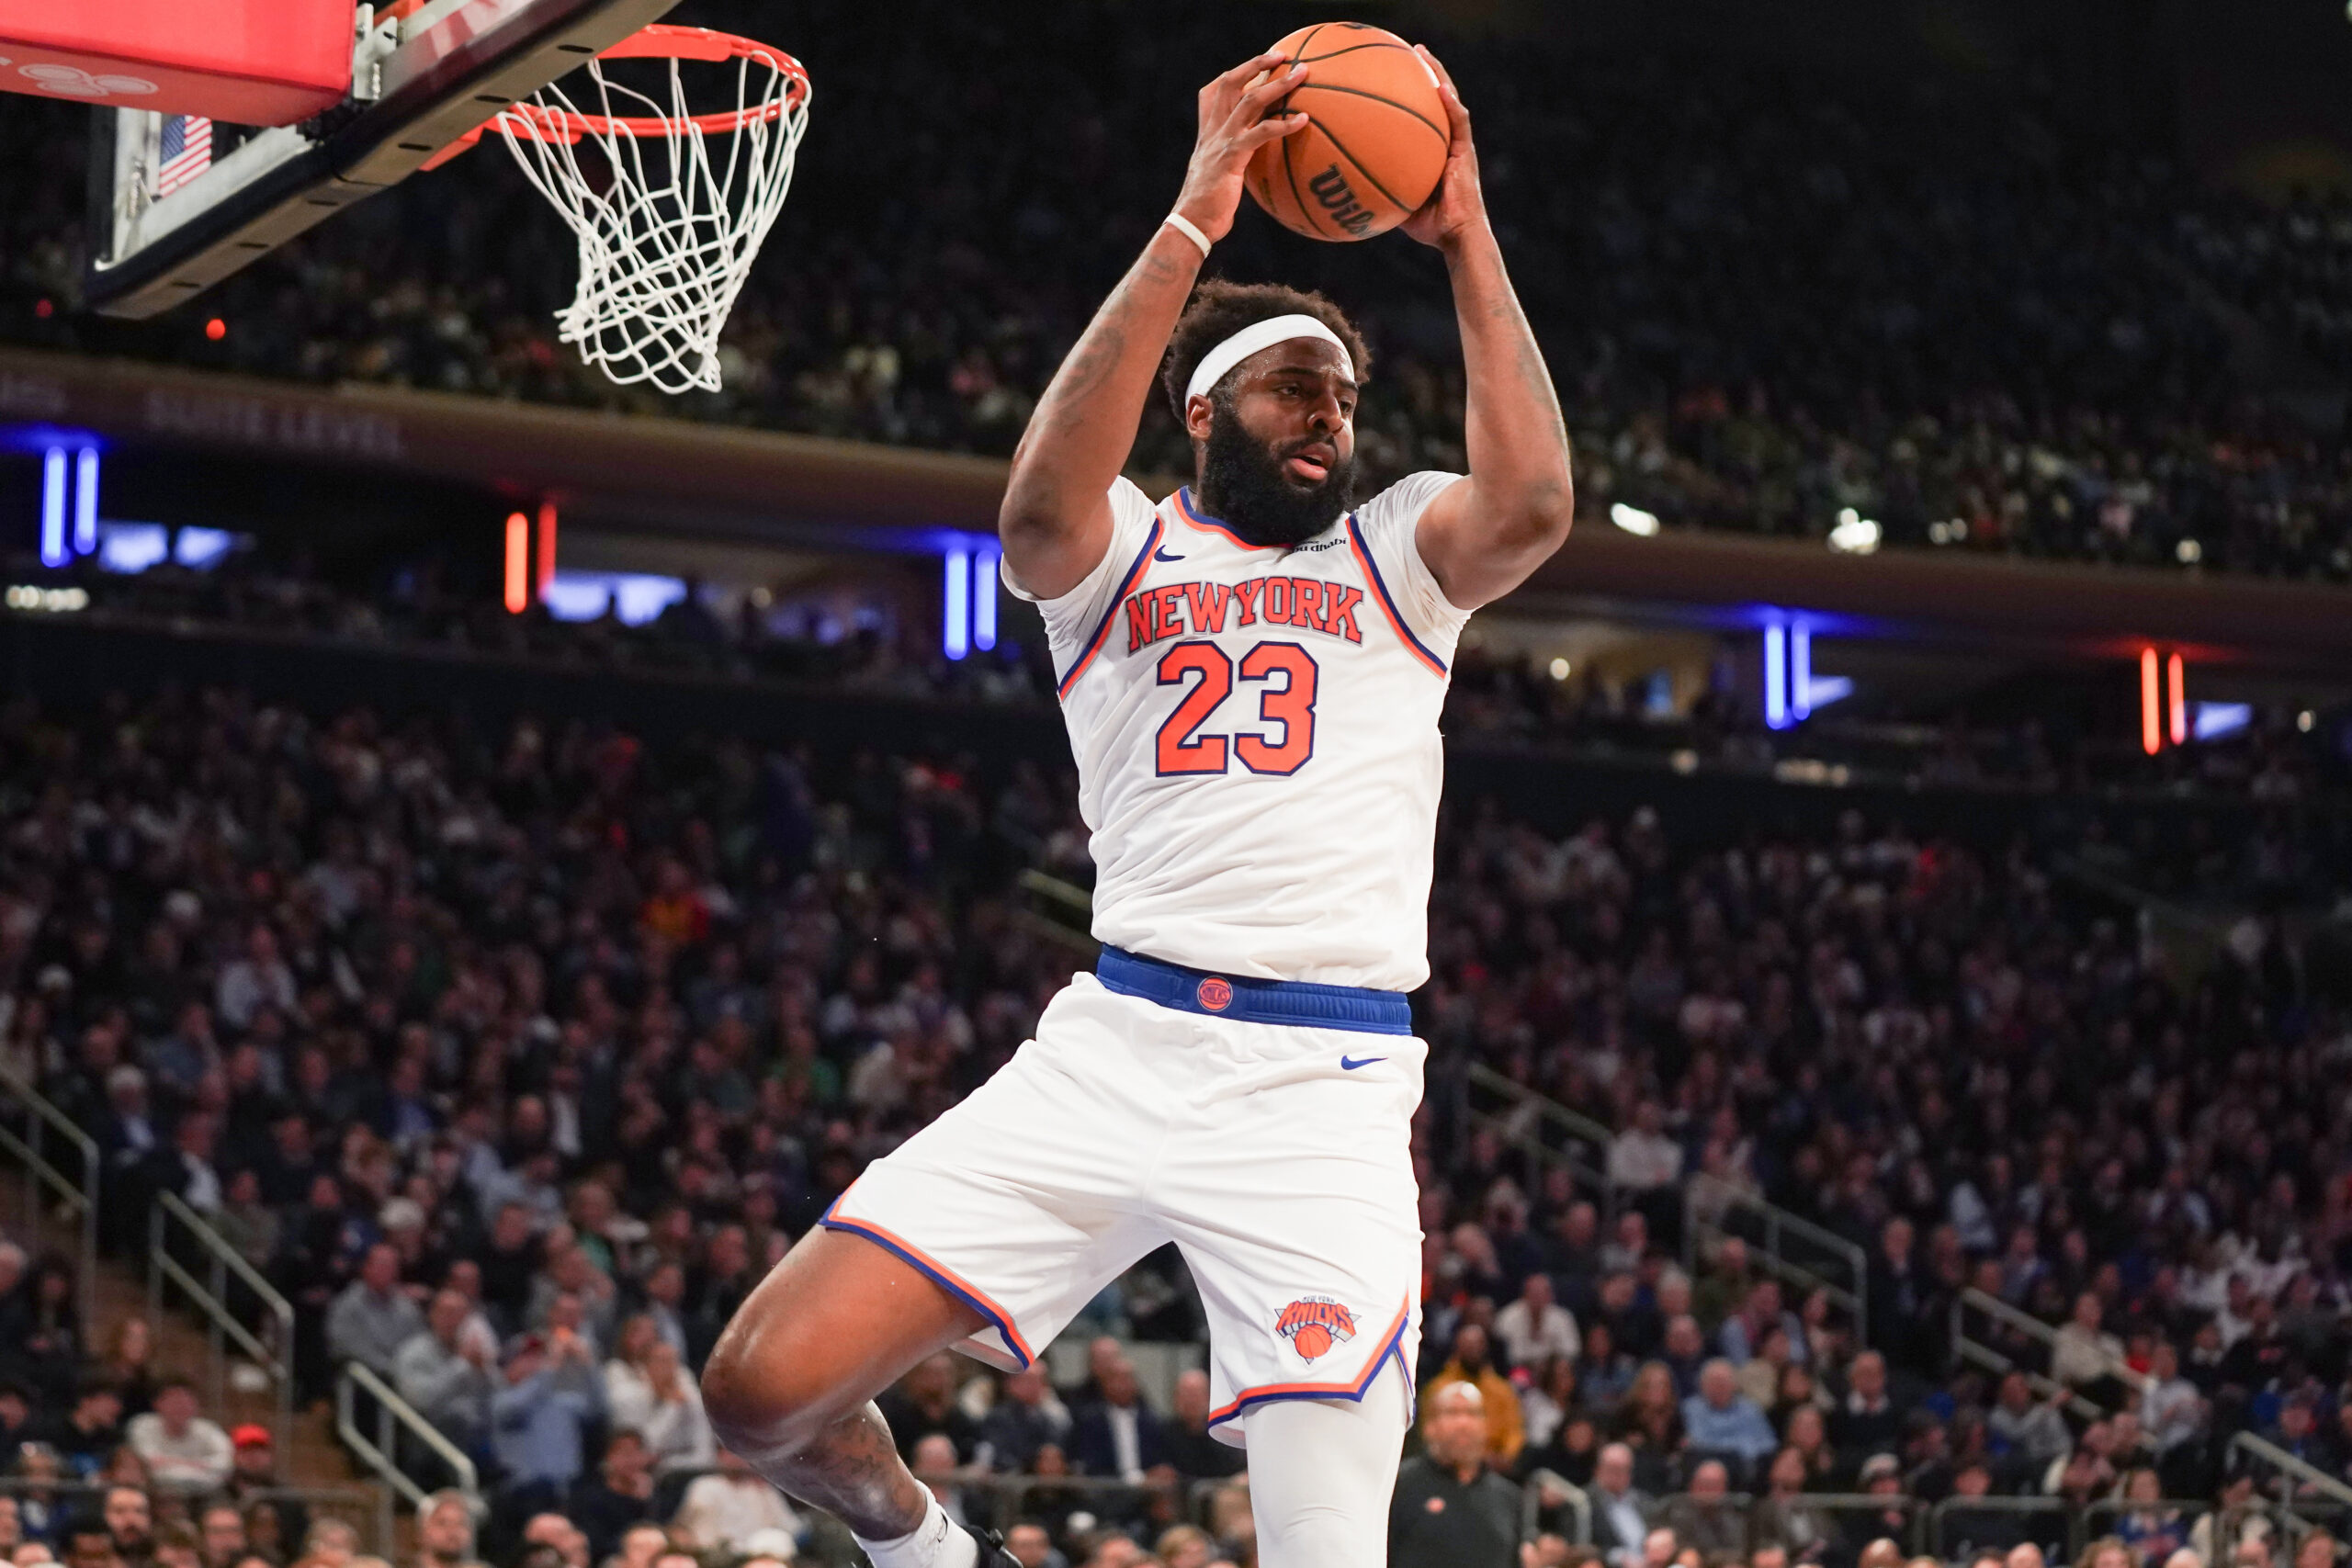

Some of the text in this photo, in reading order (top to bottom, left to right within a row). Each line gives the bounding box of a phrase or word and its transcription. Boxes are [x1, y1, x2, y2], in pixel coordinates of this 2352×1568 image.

[1310, 537, 1347, 552] dhabi
[1125, 575, 1364, 658] NEW YORK
[1155, 639, 1319, 777] 23
[1275, 1300, 1357, 1339] KNICKS
